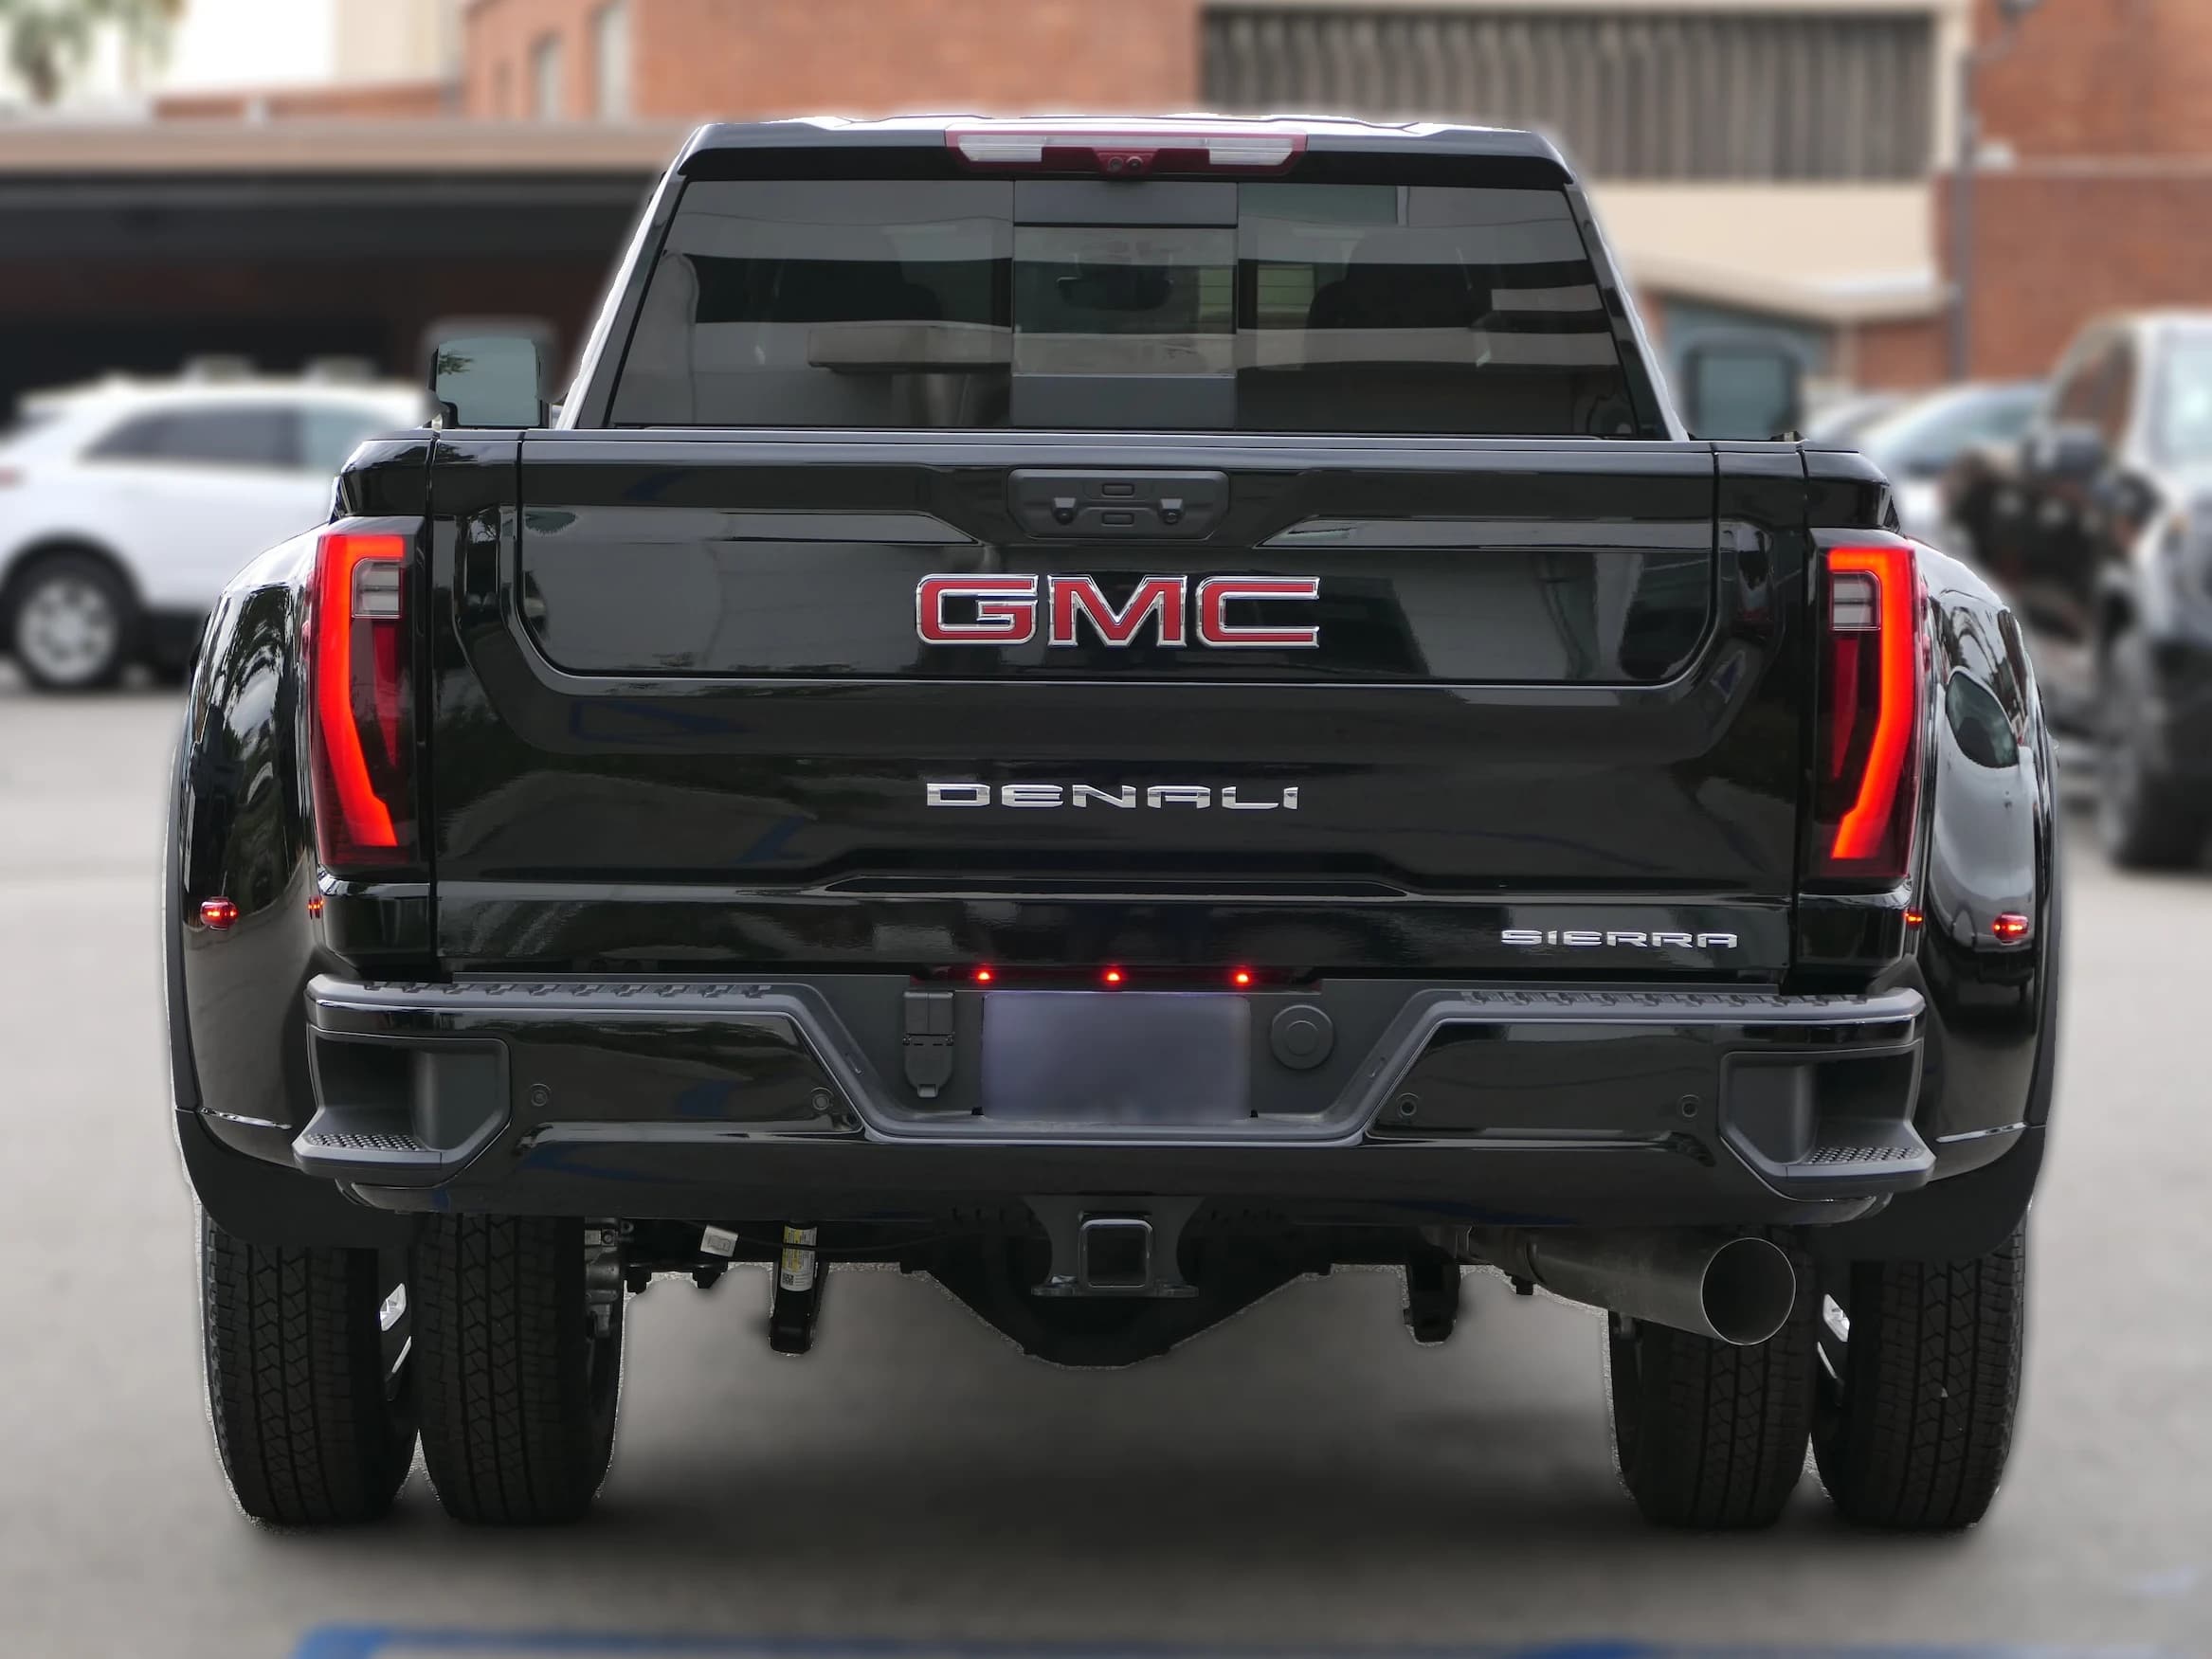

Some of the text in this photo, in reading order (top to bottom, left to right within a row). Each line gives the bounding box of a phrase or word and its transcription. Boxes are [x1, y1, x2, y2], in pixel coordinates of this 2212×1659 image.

[916, 573, 1320, 647] GMC
[926, 783, 1298, 810] DENALI
[1500, 929, 1738, 948] SIERRA
